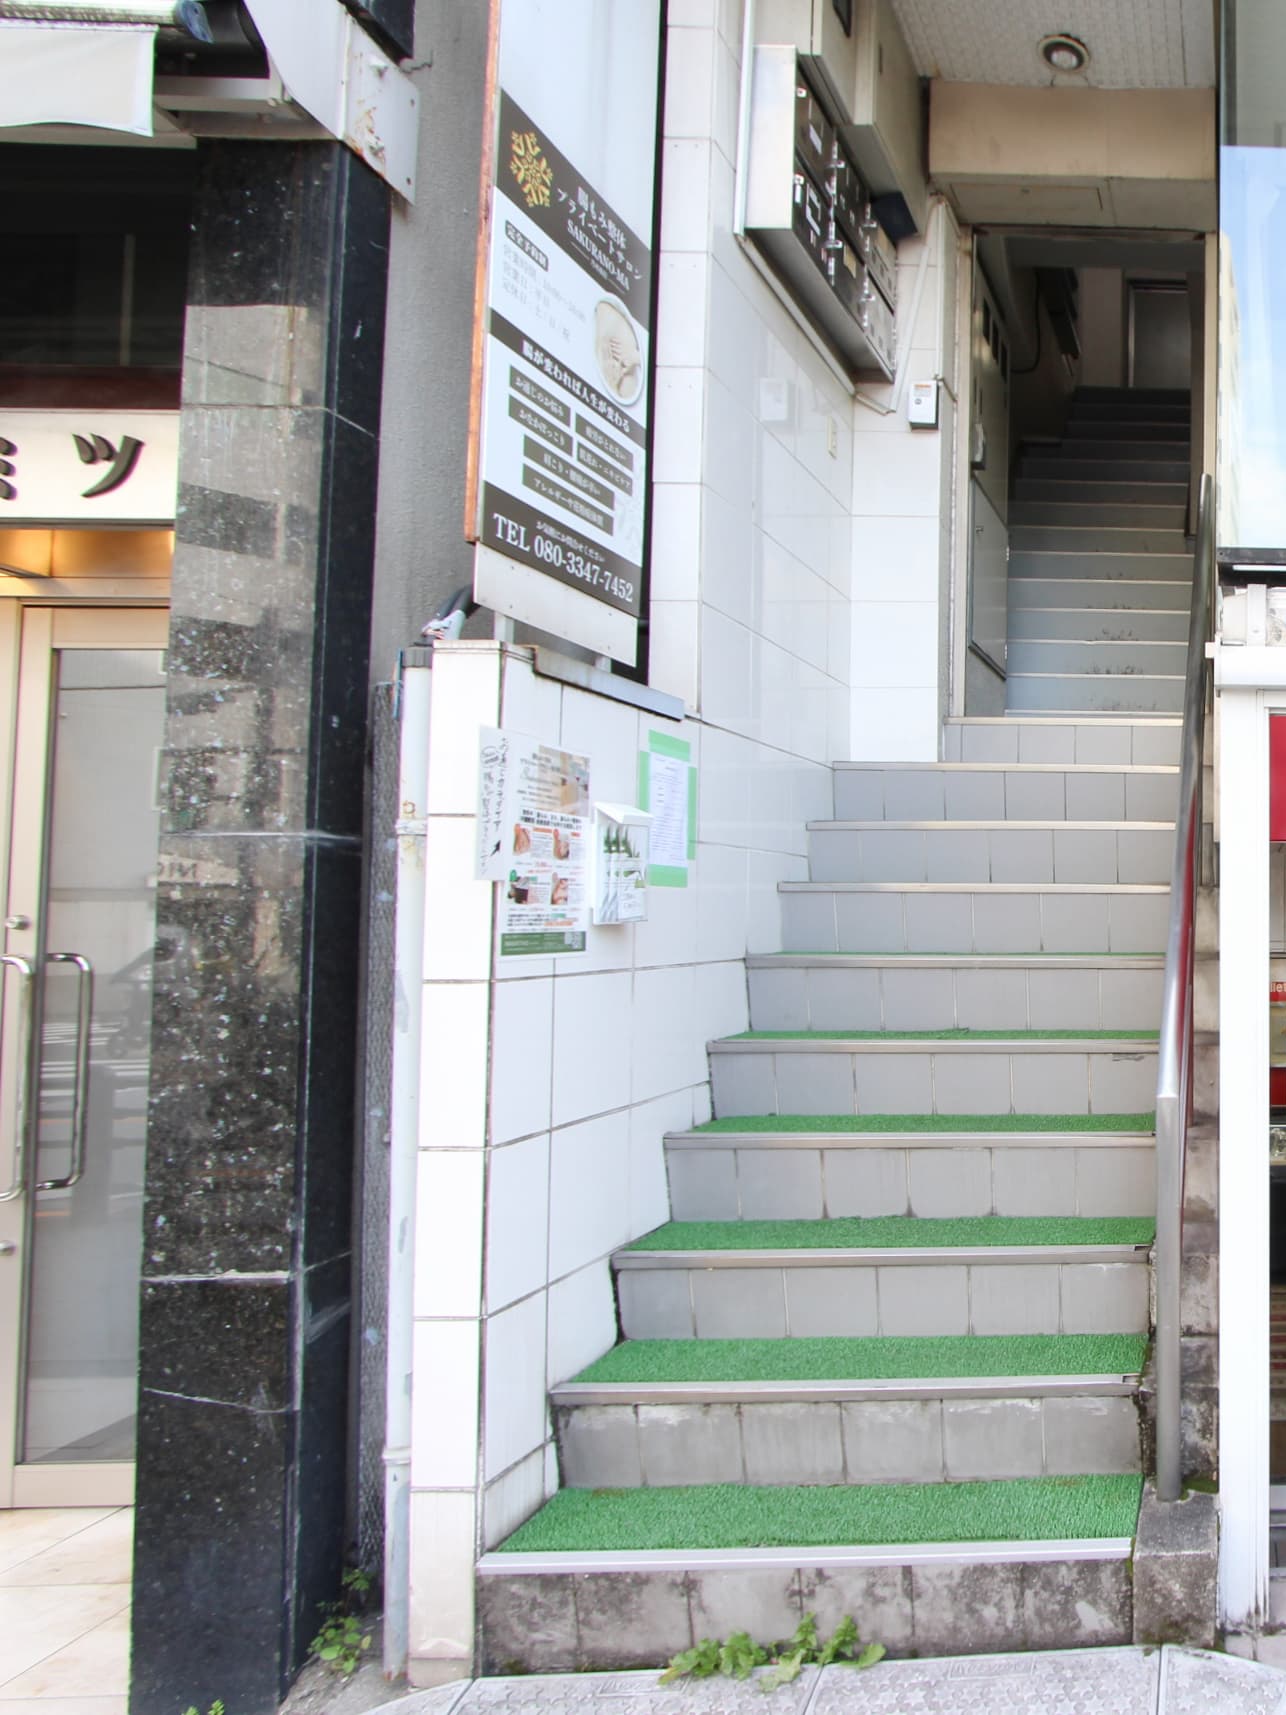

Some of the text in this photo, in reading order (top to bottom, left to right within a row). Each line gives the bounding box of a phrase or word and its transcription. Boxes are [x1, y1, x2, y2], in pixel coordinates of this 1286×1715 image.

[557, 188, 642, 281] プライベートサロン
[567, 218, 630, 290] SAKURANO-MA
[492, 512, 634, 603] TEL 080-3347-7452
